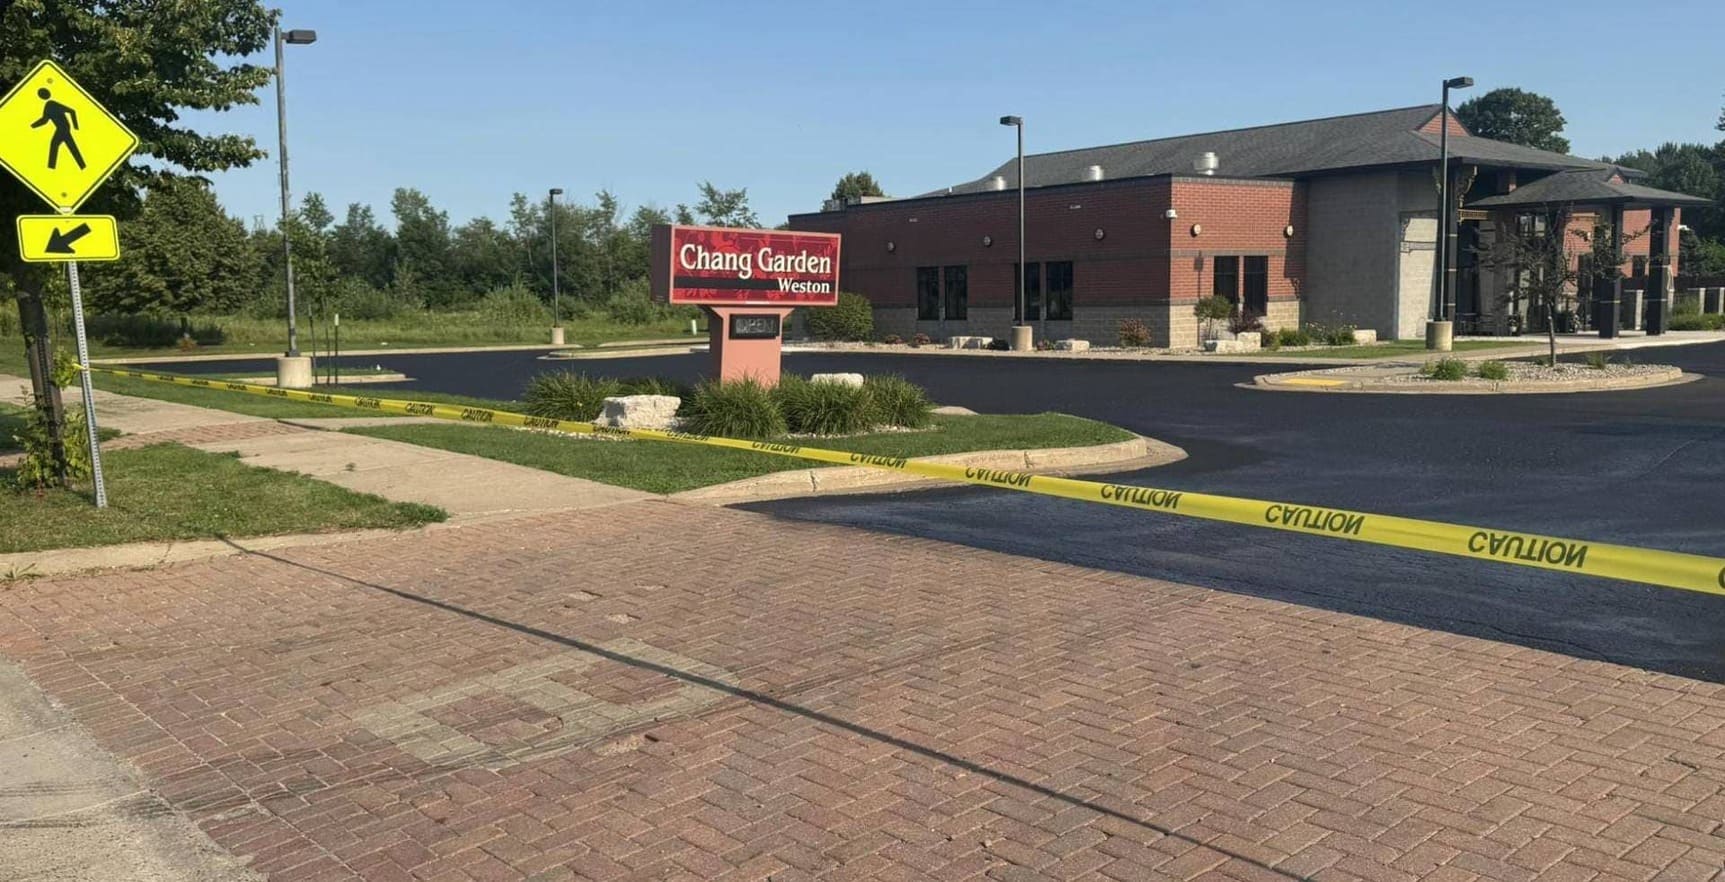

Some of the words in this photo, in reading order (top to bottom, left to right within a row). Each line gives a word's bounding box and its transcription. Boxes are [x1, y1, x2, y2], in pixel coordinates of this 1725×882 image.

[680, 244, 752, 279] Chang
[758, 247, 831, 274] Garden
[777, 277, 831, 294] Weston
